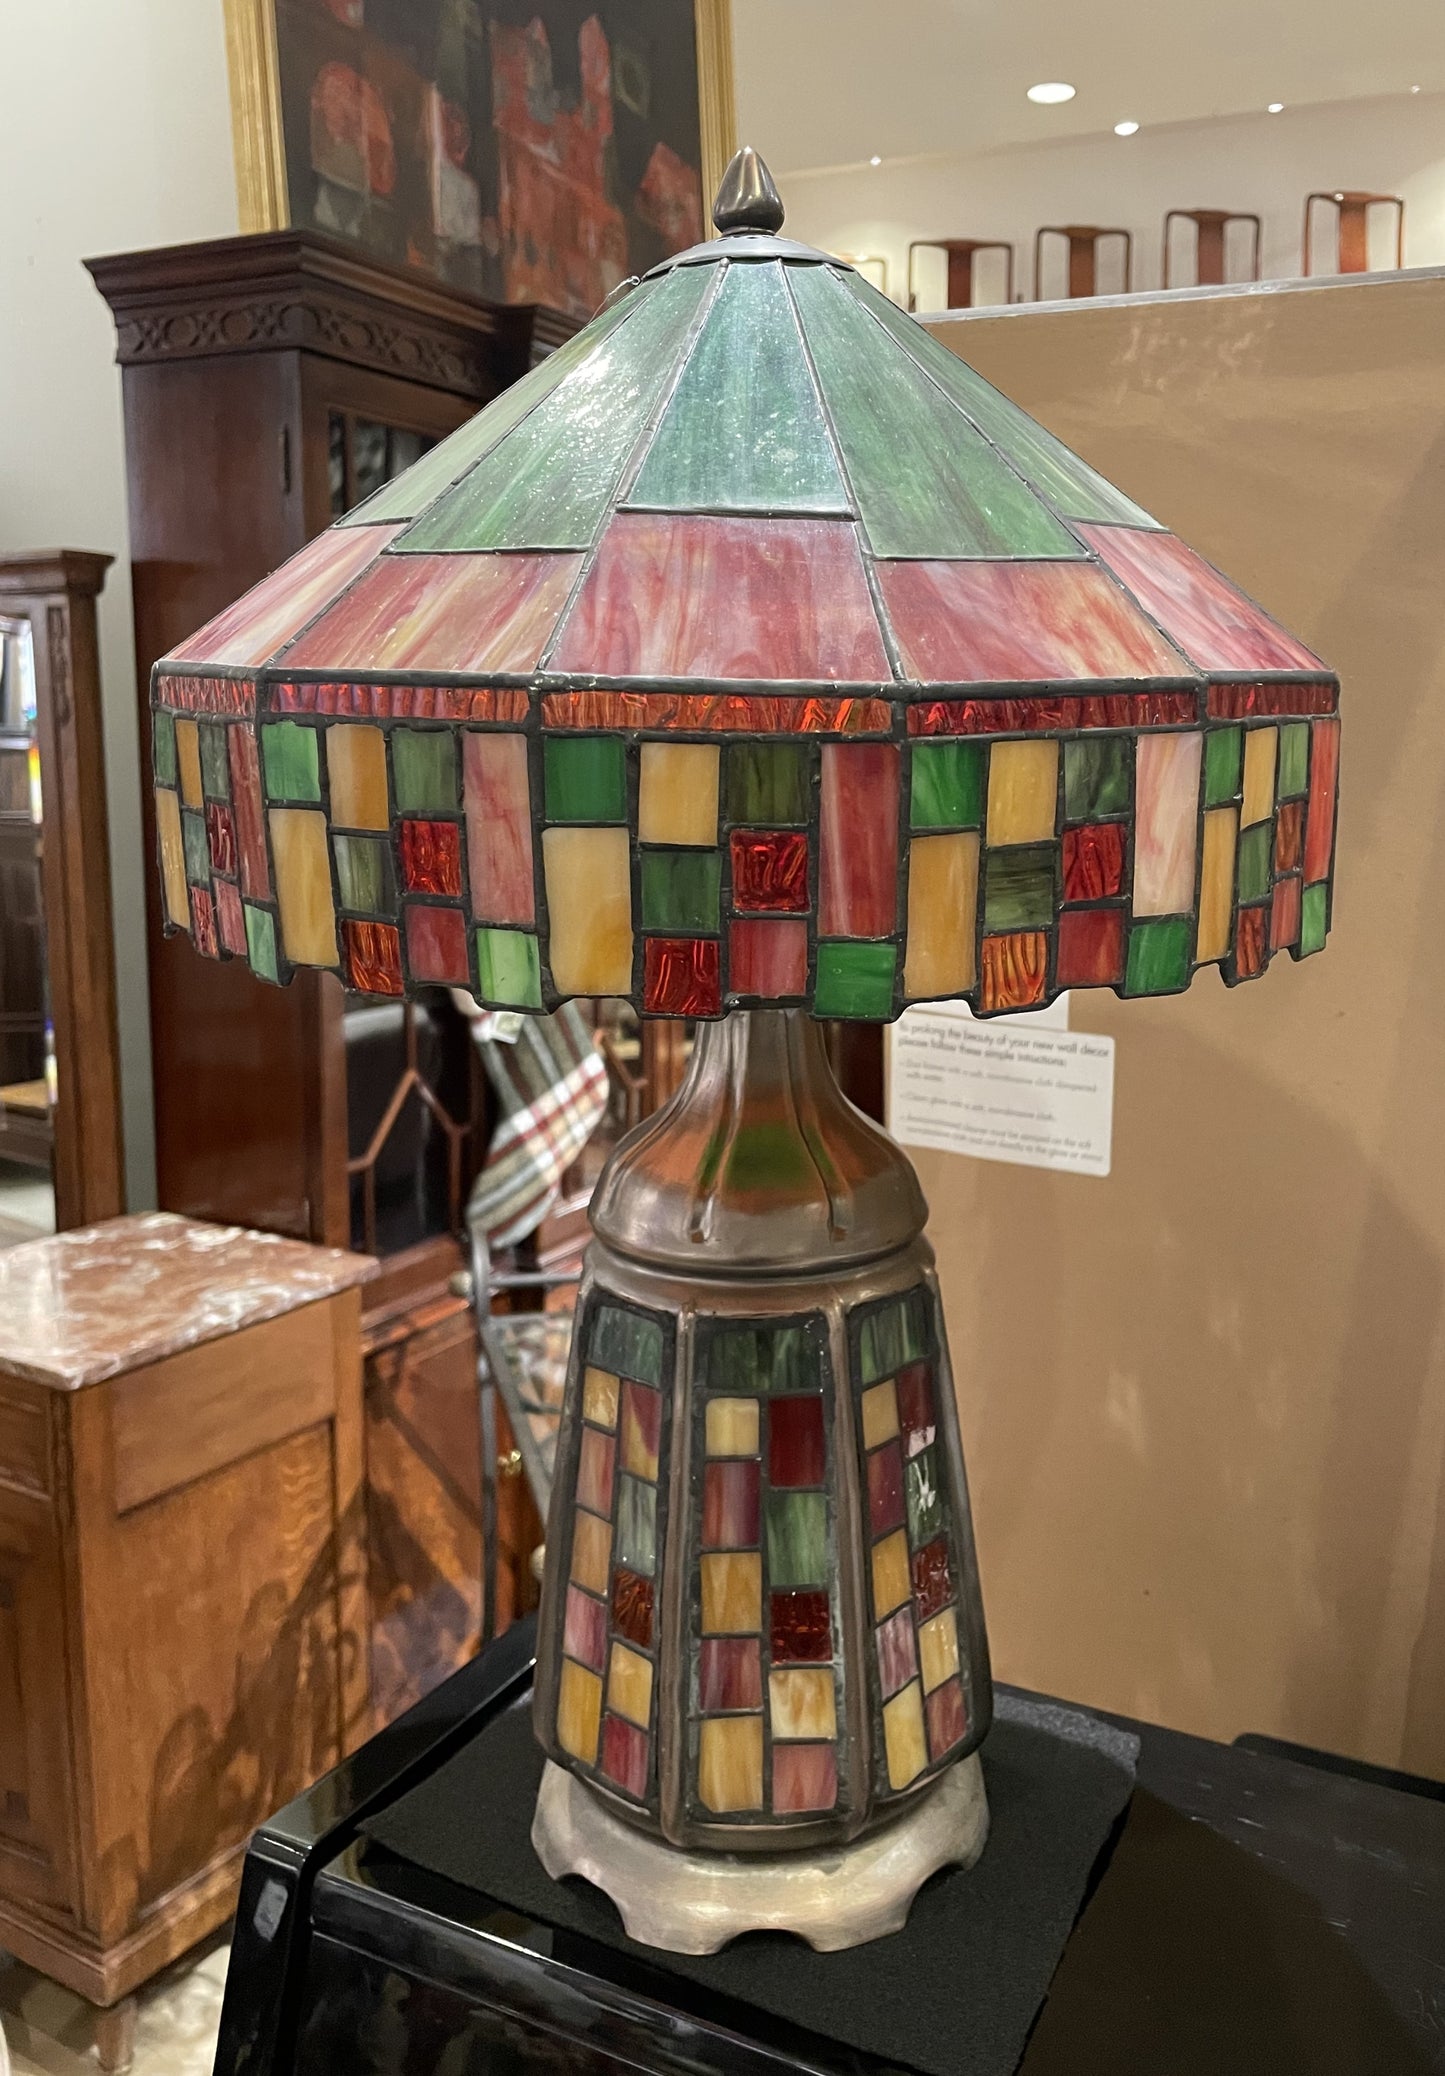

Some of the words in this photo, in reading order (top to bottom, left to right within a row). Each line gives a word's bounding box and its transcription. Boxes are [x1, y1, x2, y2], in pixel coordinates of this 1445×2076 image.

[948, 1027, 961, 1039] the
[963, 1027, 994, 1046] beauty
[996, 1034, 1007, 1045] of
[1008, 1038, 1030, 1048] your
[1032, 1041, 1054, 1050] new
[1057, 1042, 1077, 1053] wall
